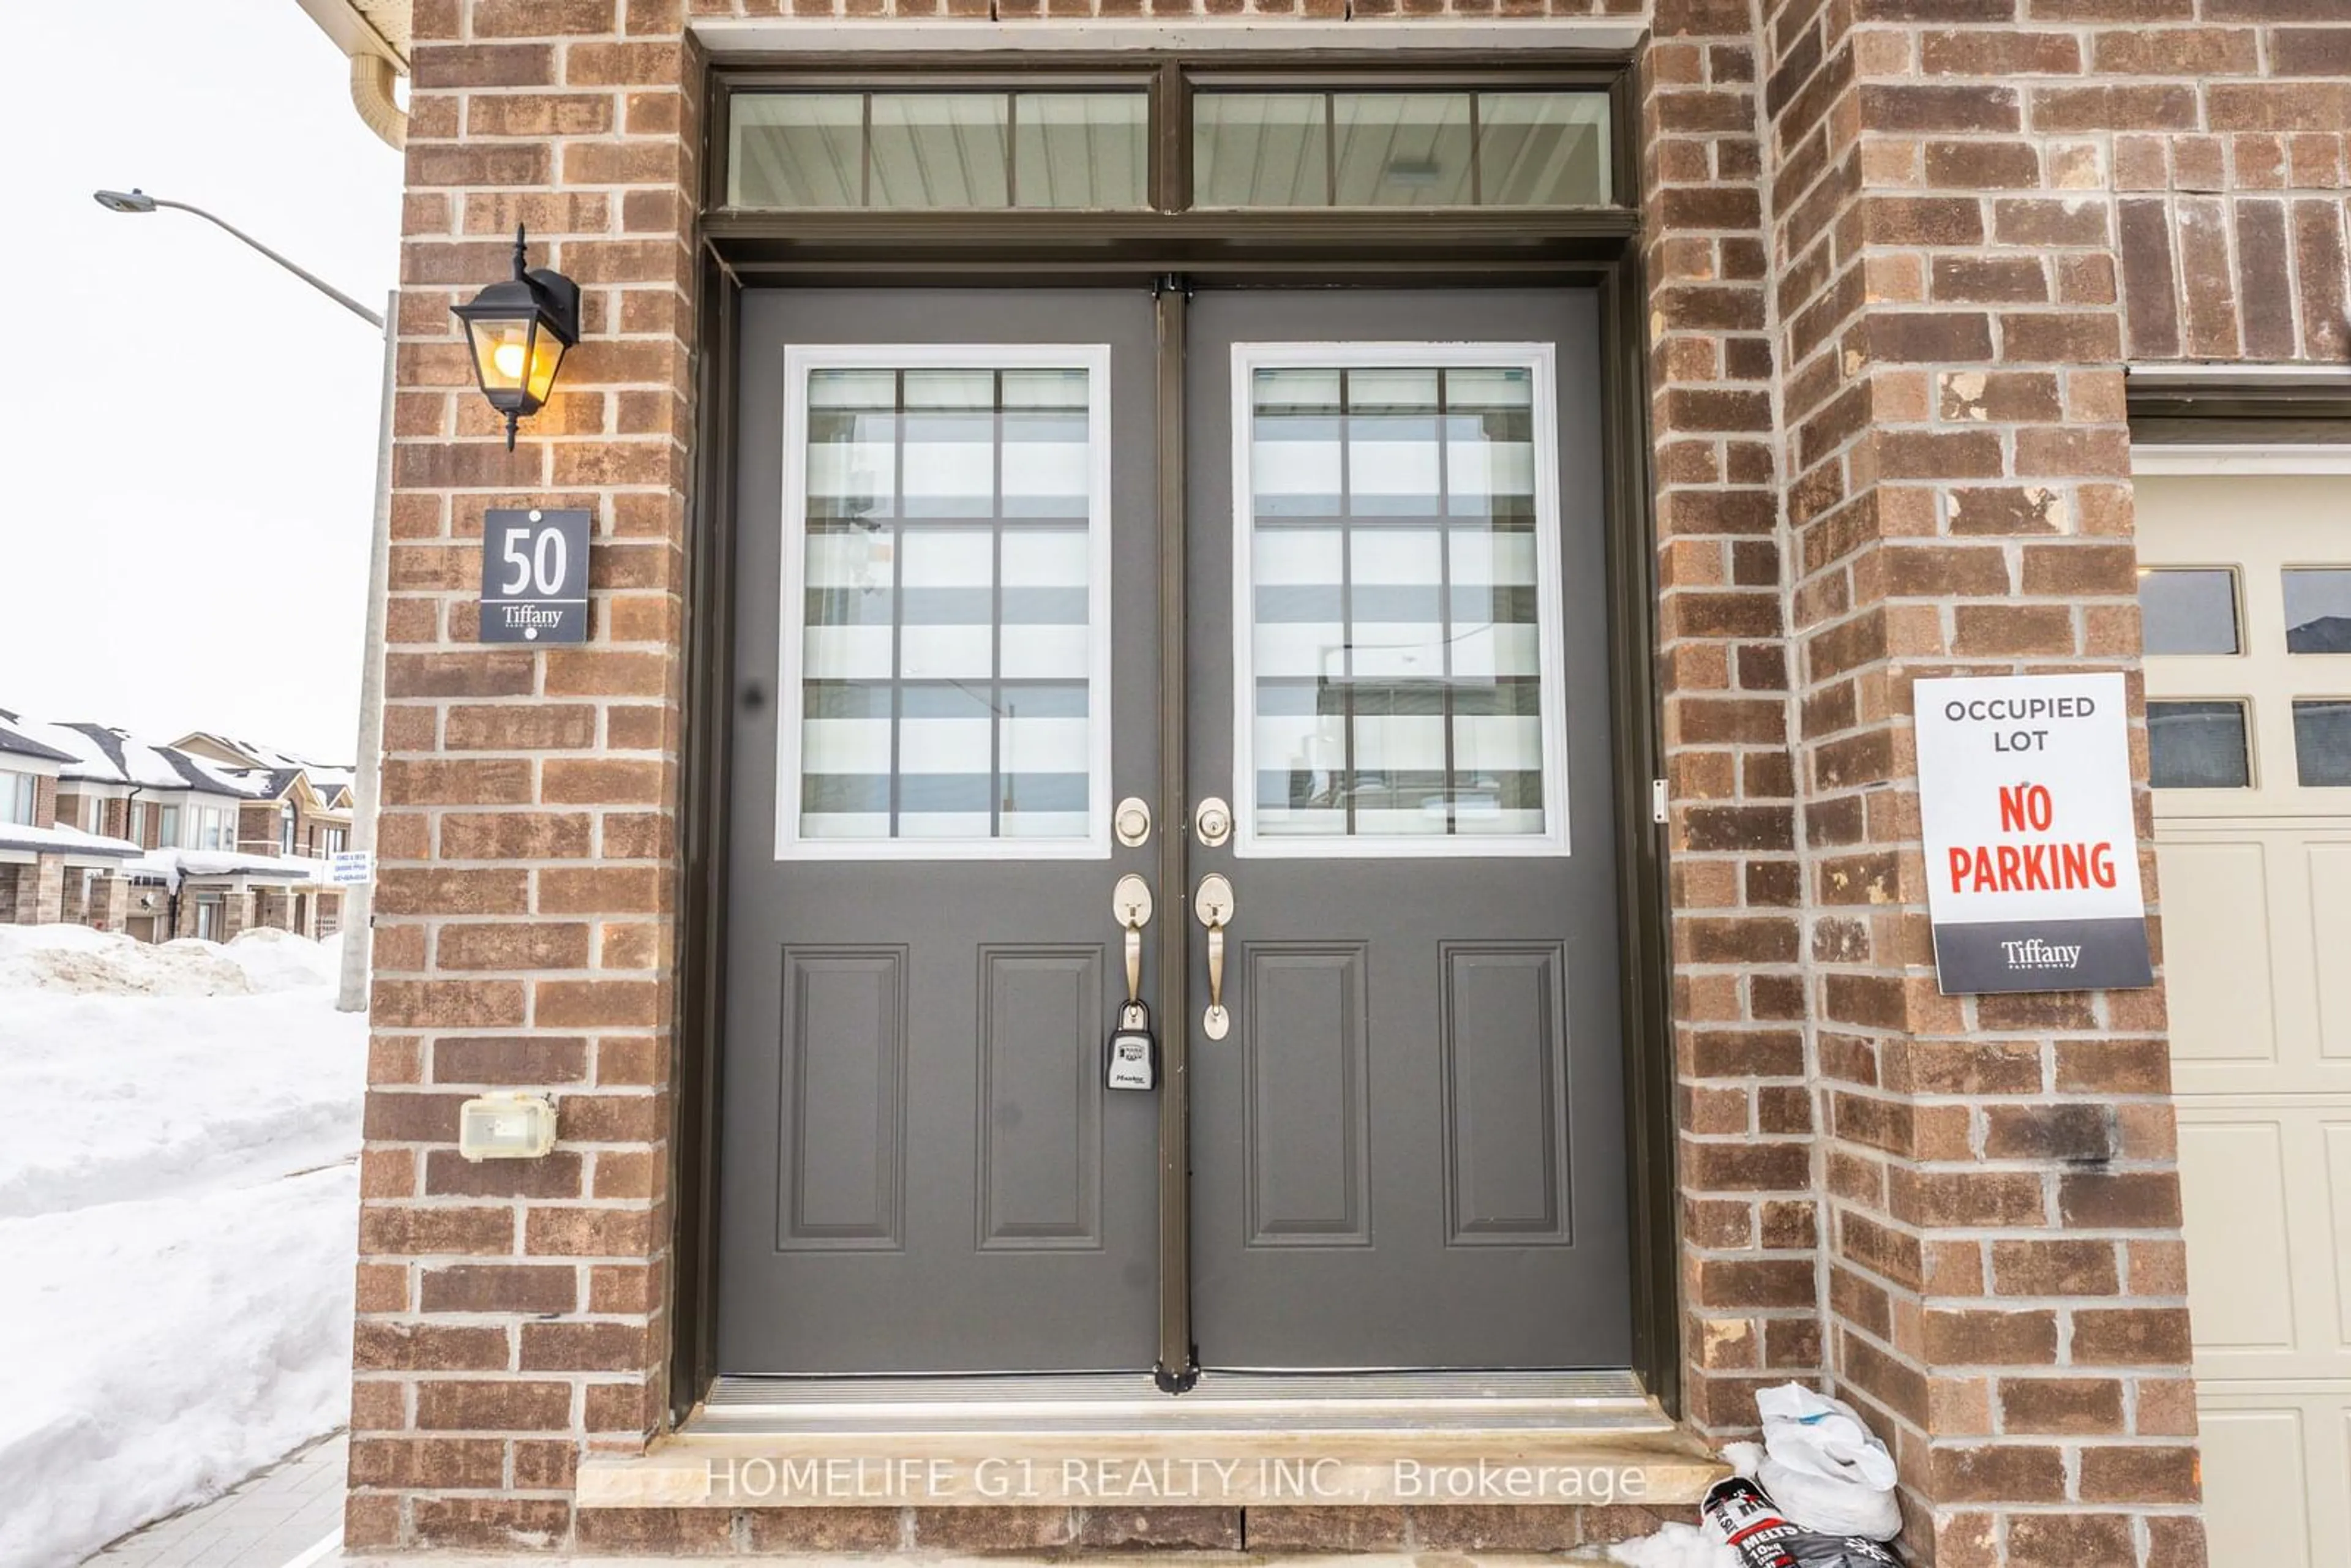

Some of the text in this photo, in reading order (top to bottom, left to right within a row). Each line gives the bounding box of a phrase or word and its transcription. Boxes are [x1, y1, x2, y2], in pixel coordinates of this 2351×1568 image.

[502, 527, 567, 595] 50
[502, 604, 563, 628] Tiffany
[1945, 697, 2094, 721] OCCUPIED
[1994, 731, 2049, 752] LOT
[1999, 785, 2053, 832] NO
[1948, 842, 2117, 893] PARKING
[2001, 939, 2082, 969] Tiffany
[1741, 1526, 1798, 1551] MELTS
